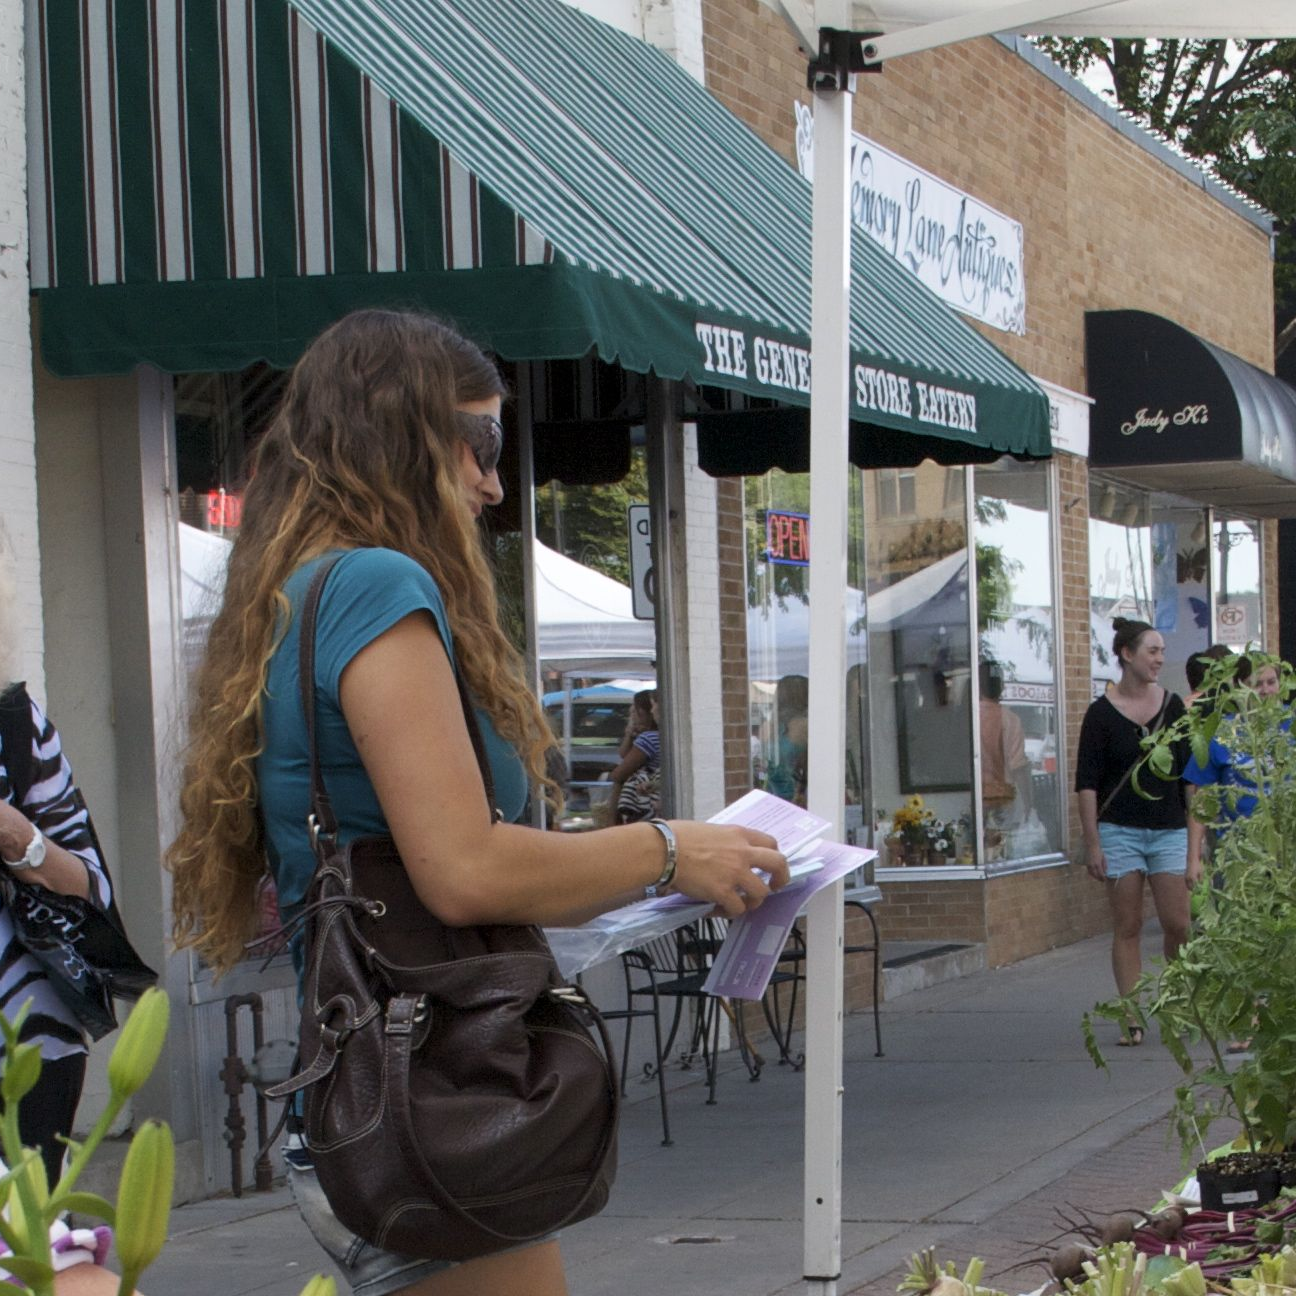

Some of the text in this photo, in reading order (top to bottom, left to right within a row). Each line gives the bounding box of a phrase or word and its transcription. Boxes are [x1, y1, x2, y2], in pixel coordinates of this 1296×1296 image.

[905, 178, 945, 274] Lane
[942, 197, 1016, 315] Antiques
[696, 322, 978, 433] THE GENE STORE EATERY
[1121, 405, 1208, 435] Judy K's
[768, 514, 809, 560] OPEN
